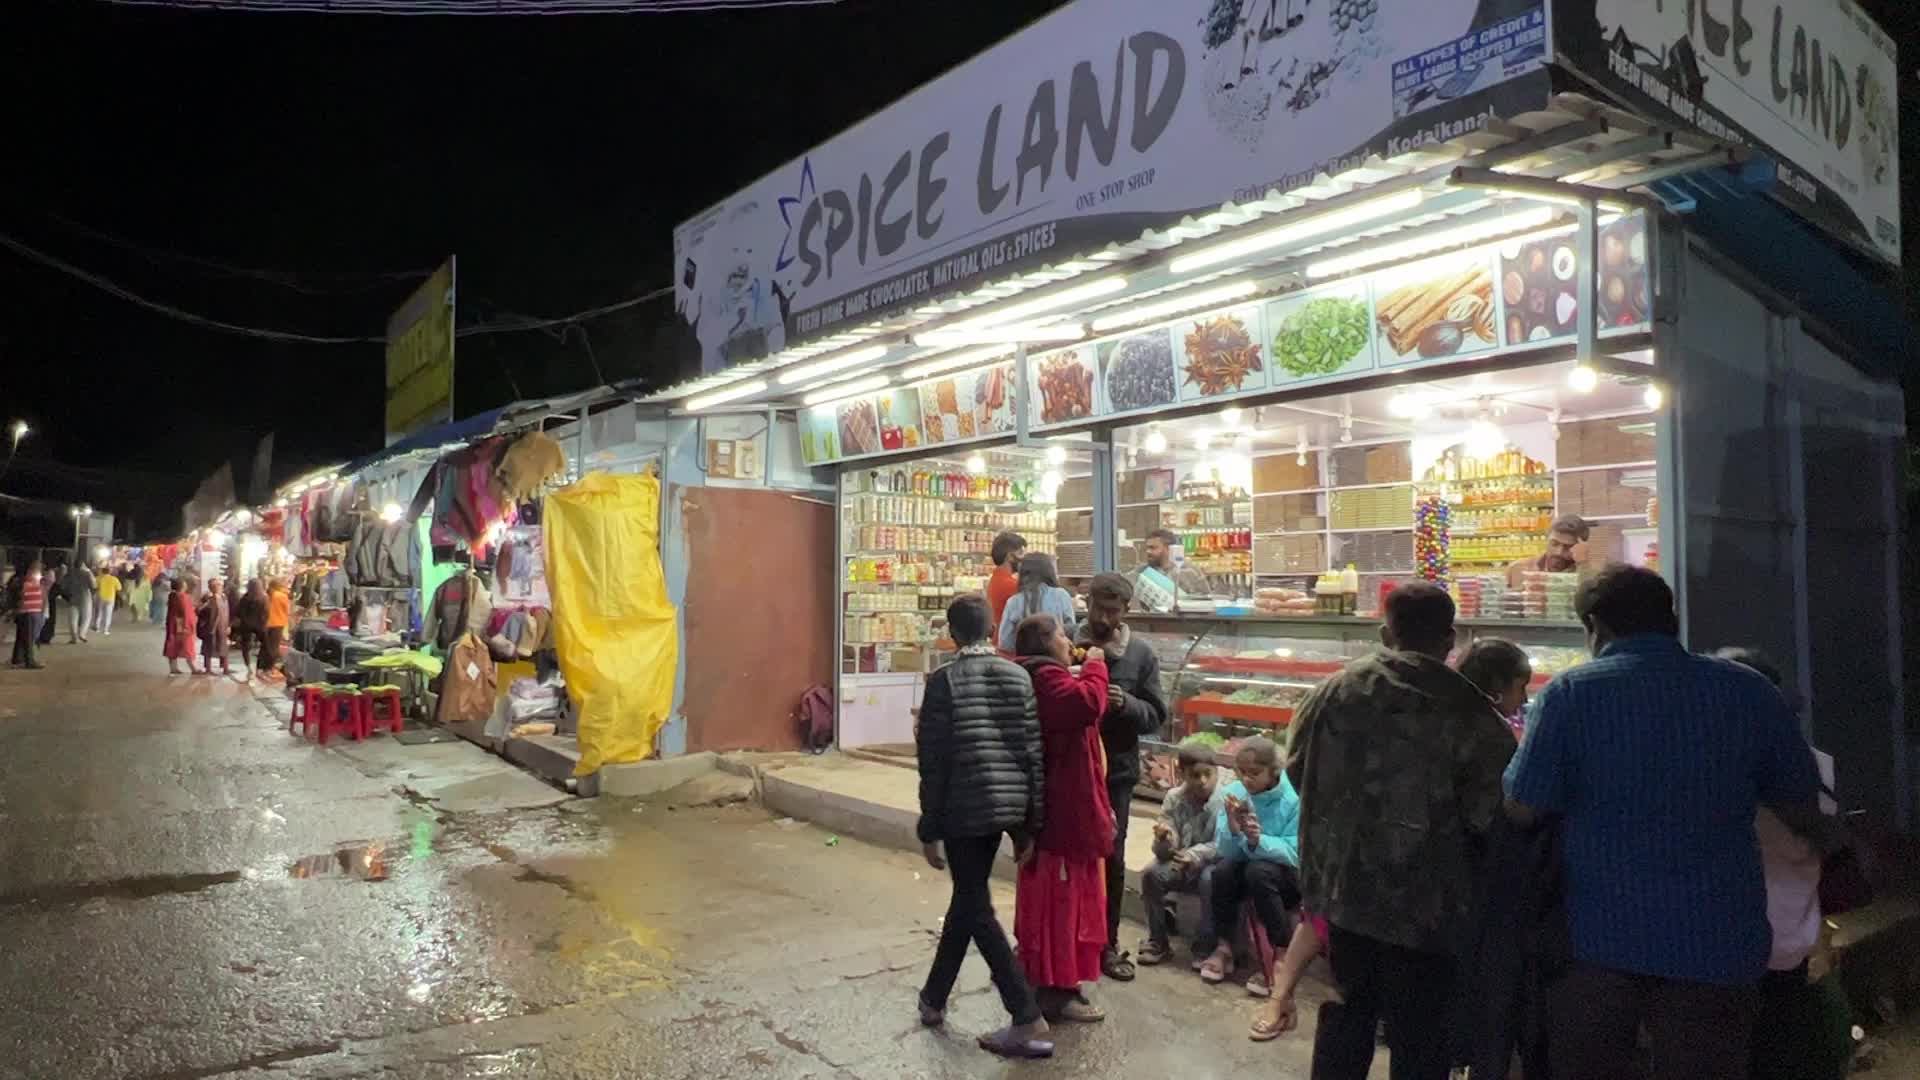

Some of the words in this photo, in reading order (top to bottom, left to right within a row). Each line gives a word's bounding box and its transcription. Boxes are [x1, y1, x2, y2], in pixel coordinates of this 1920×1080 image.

[1395, 57, 1415, 76] ALL
[1420, 42, 1457, 68] TYPES
[1459, 35, 1476, 52] OF
[1479, 15, 1528, 45] CREDIT
[1532, 10, 1544, 25] &
[1423, 59, 1457, 81] CARDS
[1458, 36, 1513, 67] ACCEPTED
[1608, 49, 1641, 88] FRESH
[1770, 5, 1850, 150] LAND
[799, 131, 950, 288] SPICE
[977, 31, 1186, 215] LAND
[1387, 104, 1496, 157] Kodaikanal
[1076, 191, 1096, 211] ONE
[1100, 179, 1124, 202] STOP
[1128, 167, 1156, 192] SHOP
[933, 251, 980, 288] NATURAL
[982, 240, 1007, 271] OILS
[1014, 222, 1057, 260] SPICES
